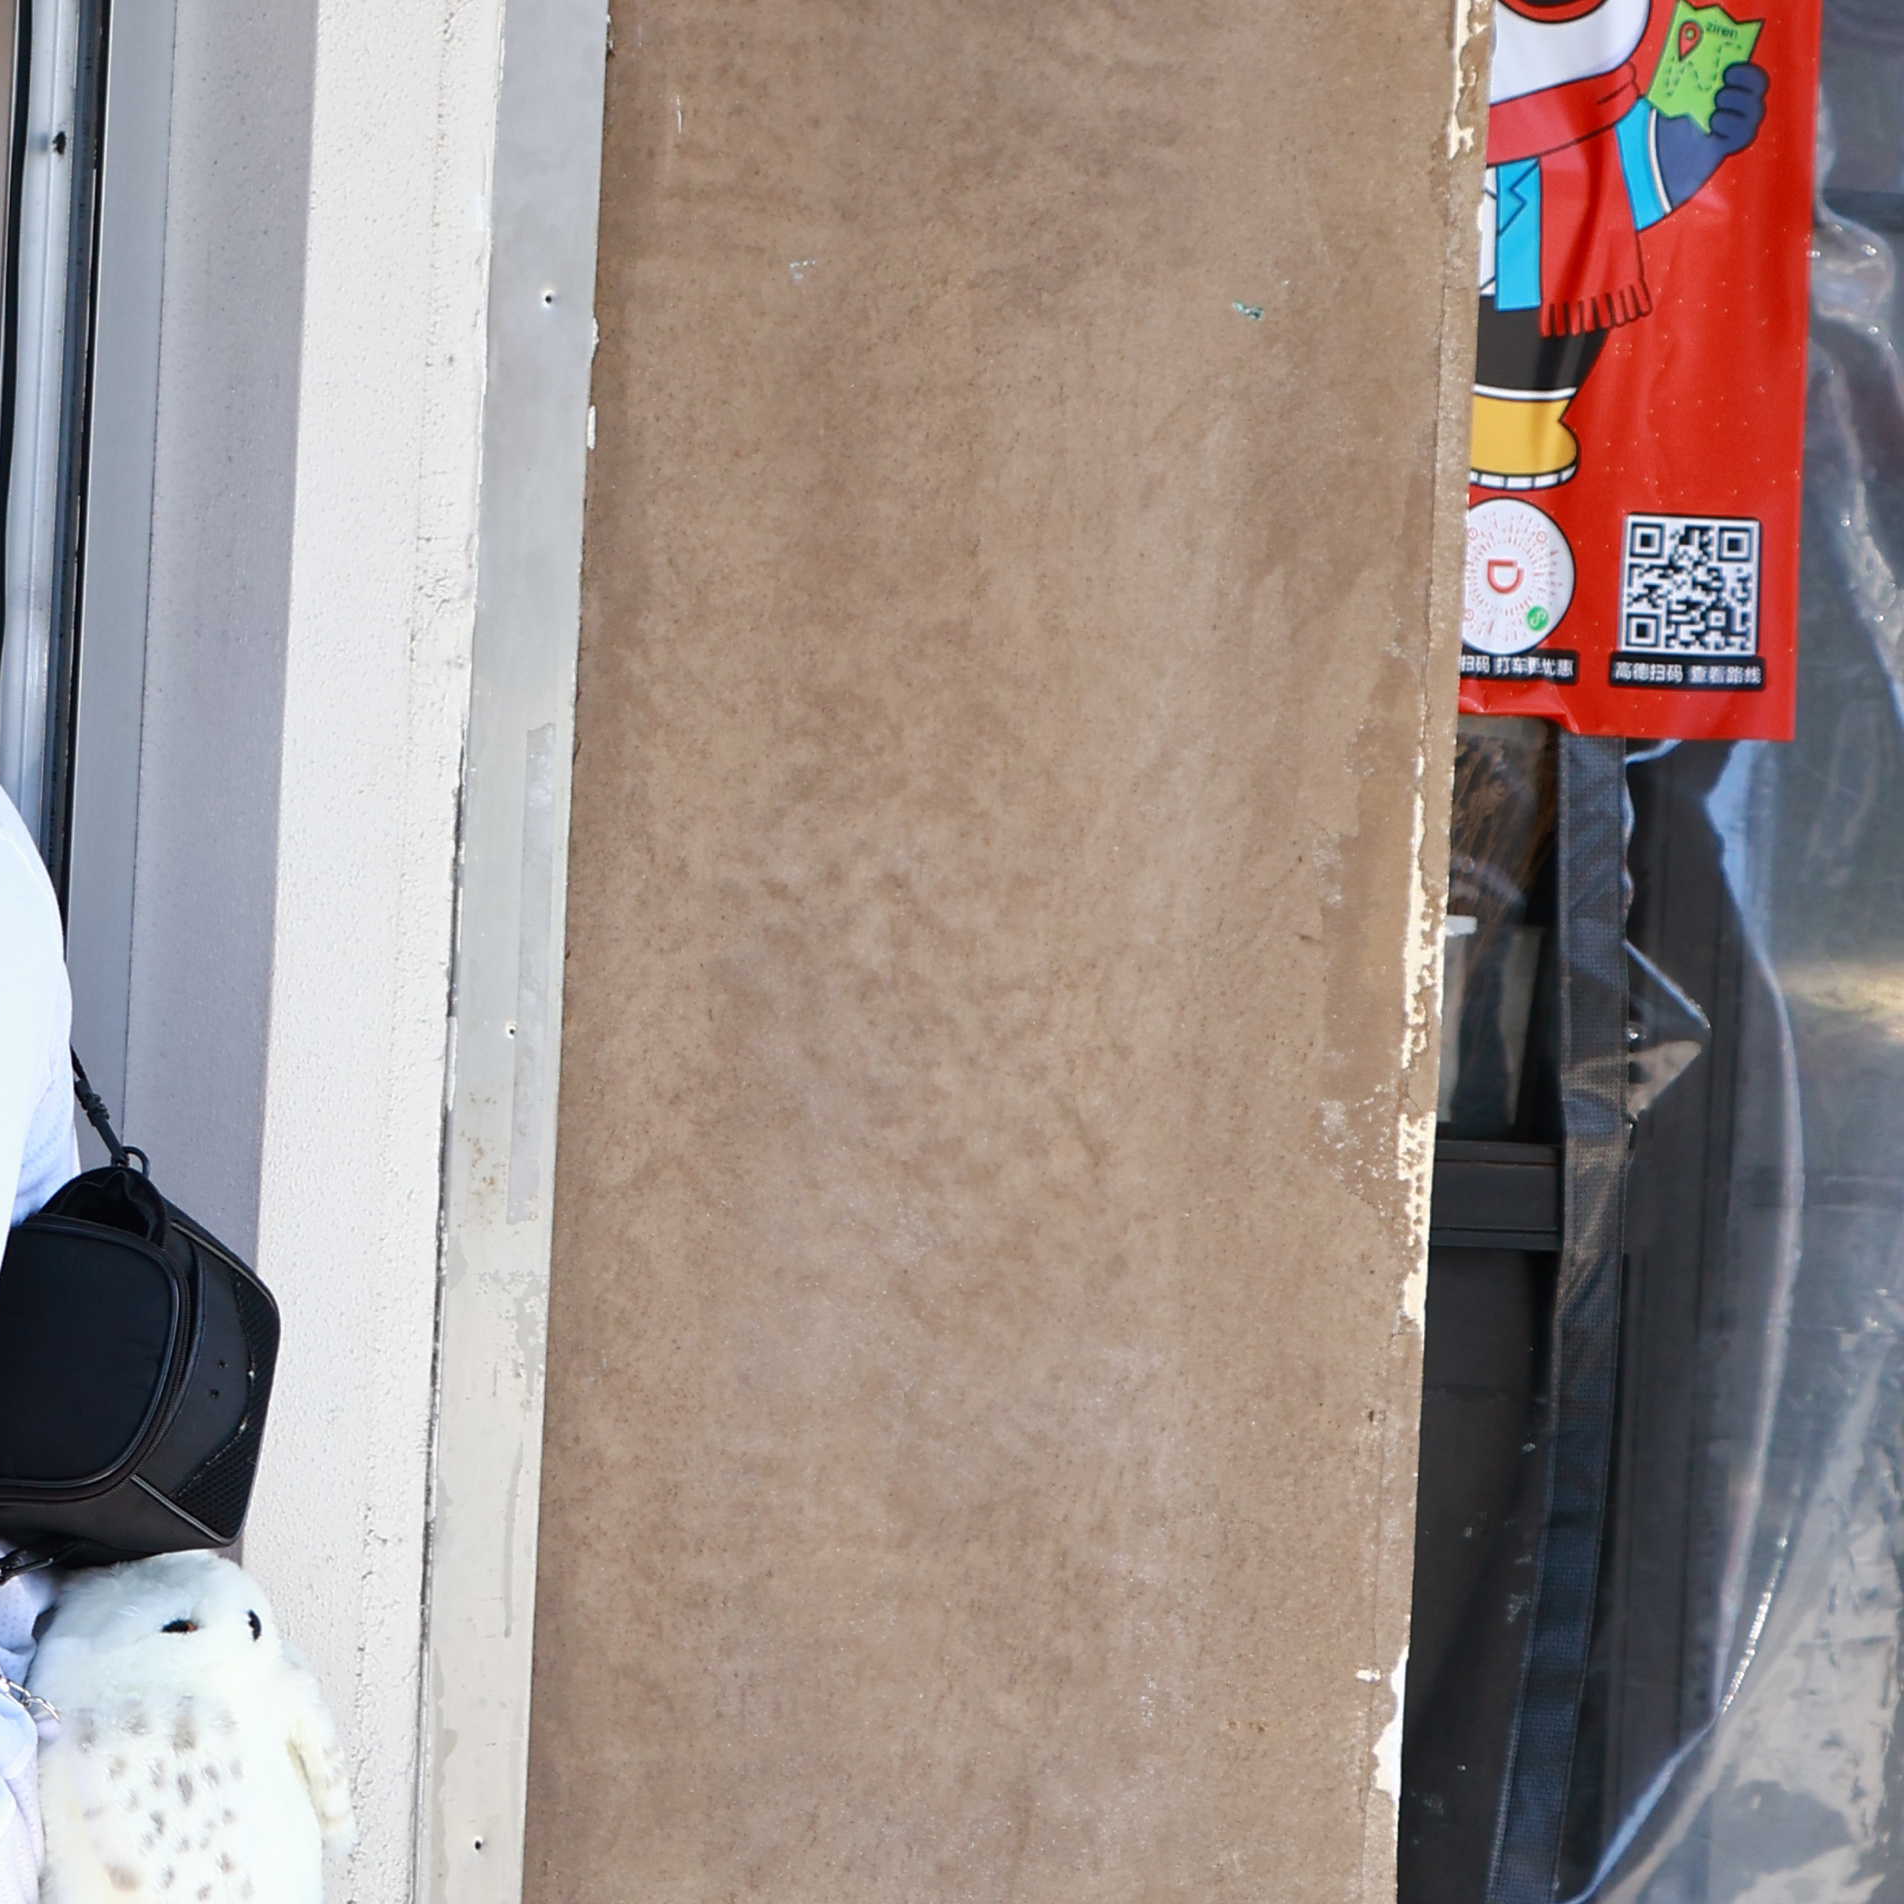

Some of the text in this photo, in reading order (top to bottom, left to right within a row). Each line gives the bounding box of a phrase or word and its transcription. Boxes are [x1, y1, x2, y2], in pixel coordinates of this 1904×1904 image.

[1615, 661, 1763, 685] 高德扫码 查看路线
